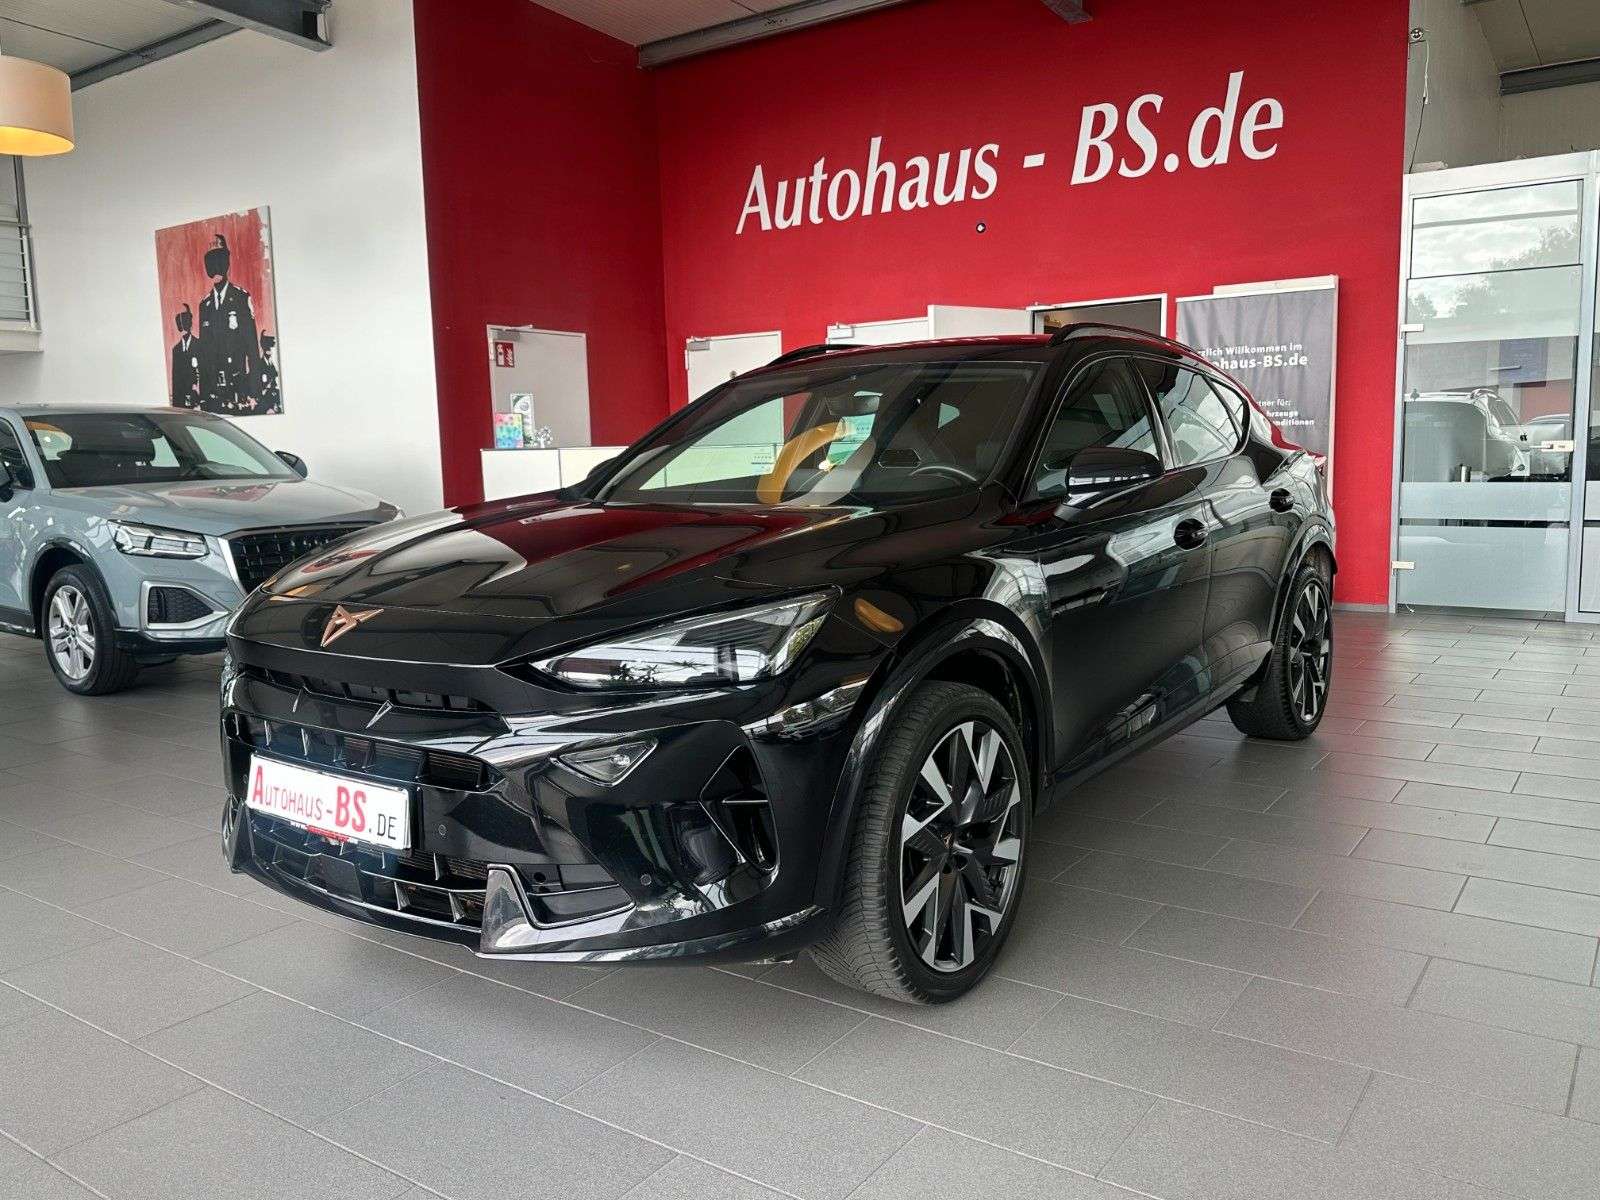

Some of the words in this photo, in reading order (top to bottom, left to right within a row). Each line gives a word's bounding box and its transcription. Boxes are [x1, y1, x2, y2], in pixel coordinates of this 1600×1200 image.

[735, 135, 1000, 235] Autohaus
[1070, 70, 1284, 185] BS.de
[1226, 345, 1287, 355] Willkommen
